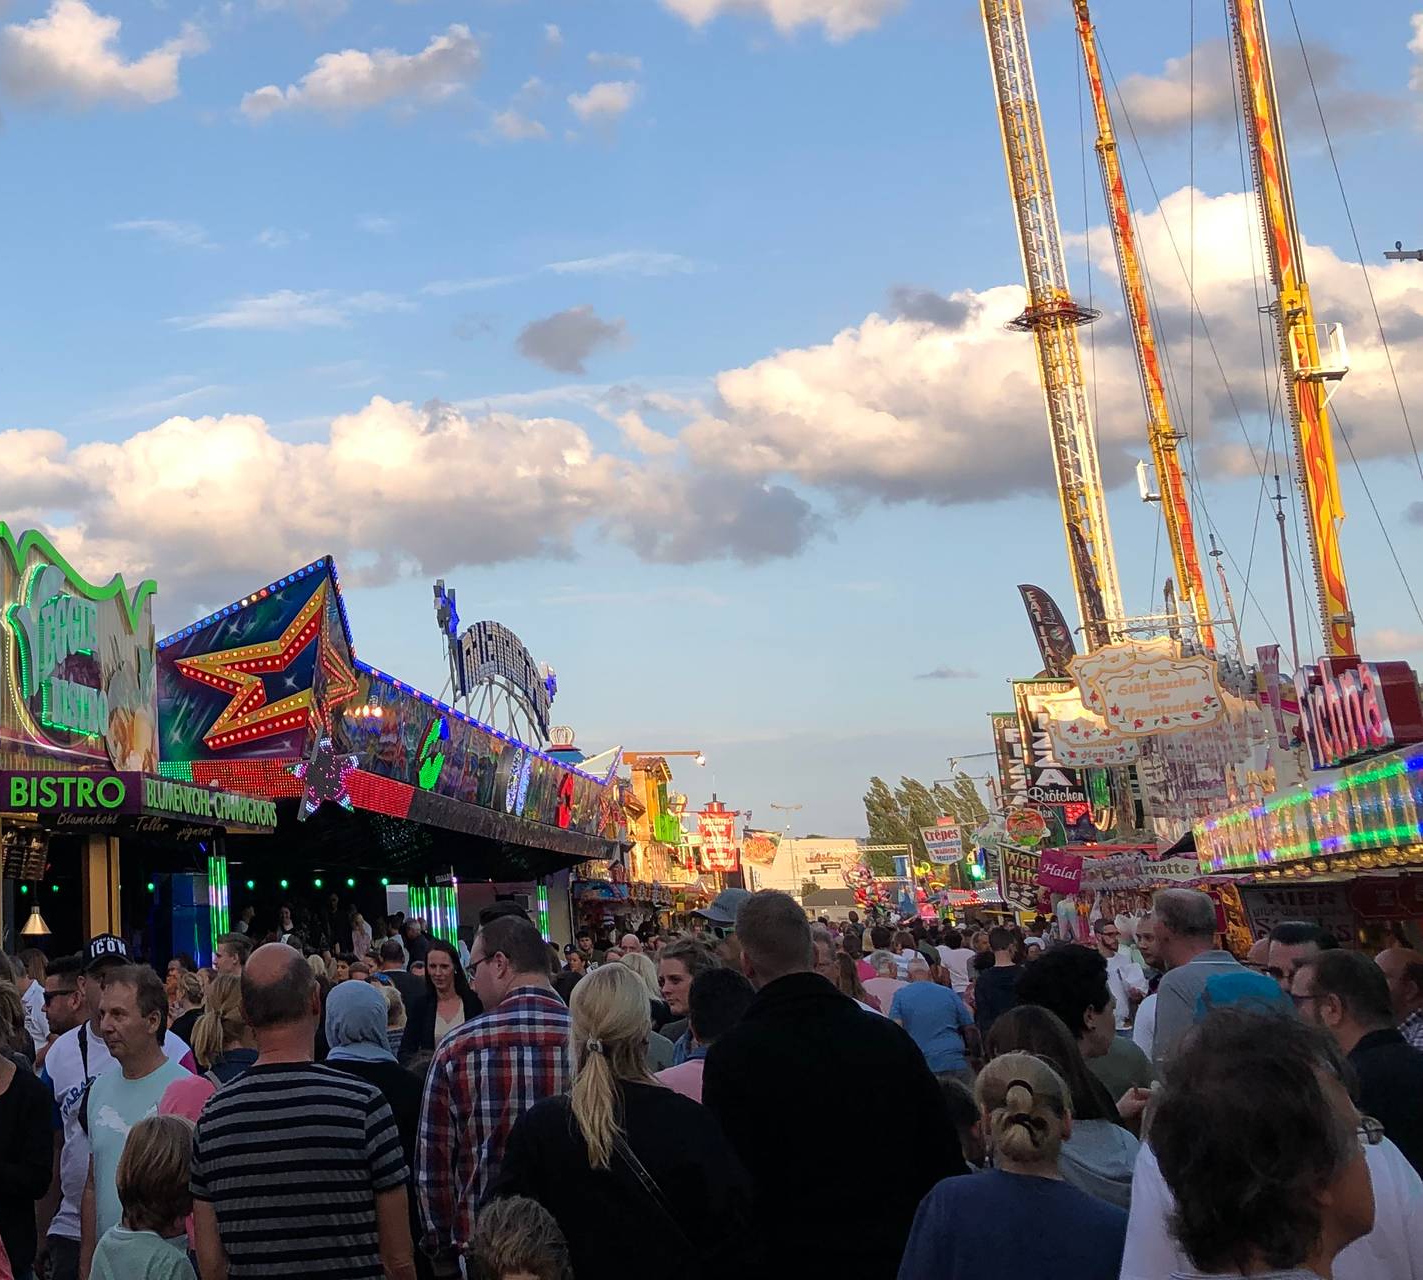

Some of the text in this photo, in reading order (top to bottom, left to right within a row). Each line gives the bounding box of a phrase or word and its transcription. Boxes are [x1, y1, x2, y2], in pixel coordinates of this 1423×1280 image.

[10, 776, 126, 808] BISTRO
[1028, 787, 1084, 802] Brötchen
[924, 829, 959, 841] Crêpes
[1042, 864, 1078, 880] Halal
[1143, 863, 1190, 874] rwatte
[91, 940, 127, 958] ICON
